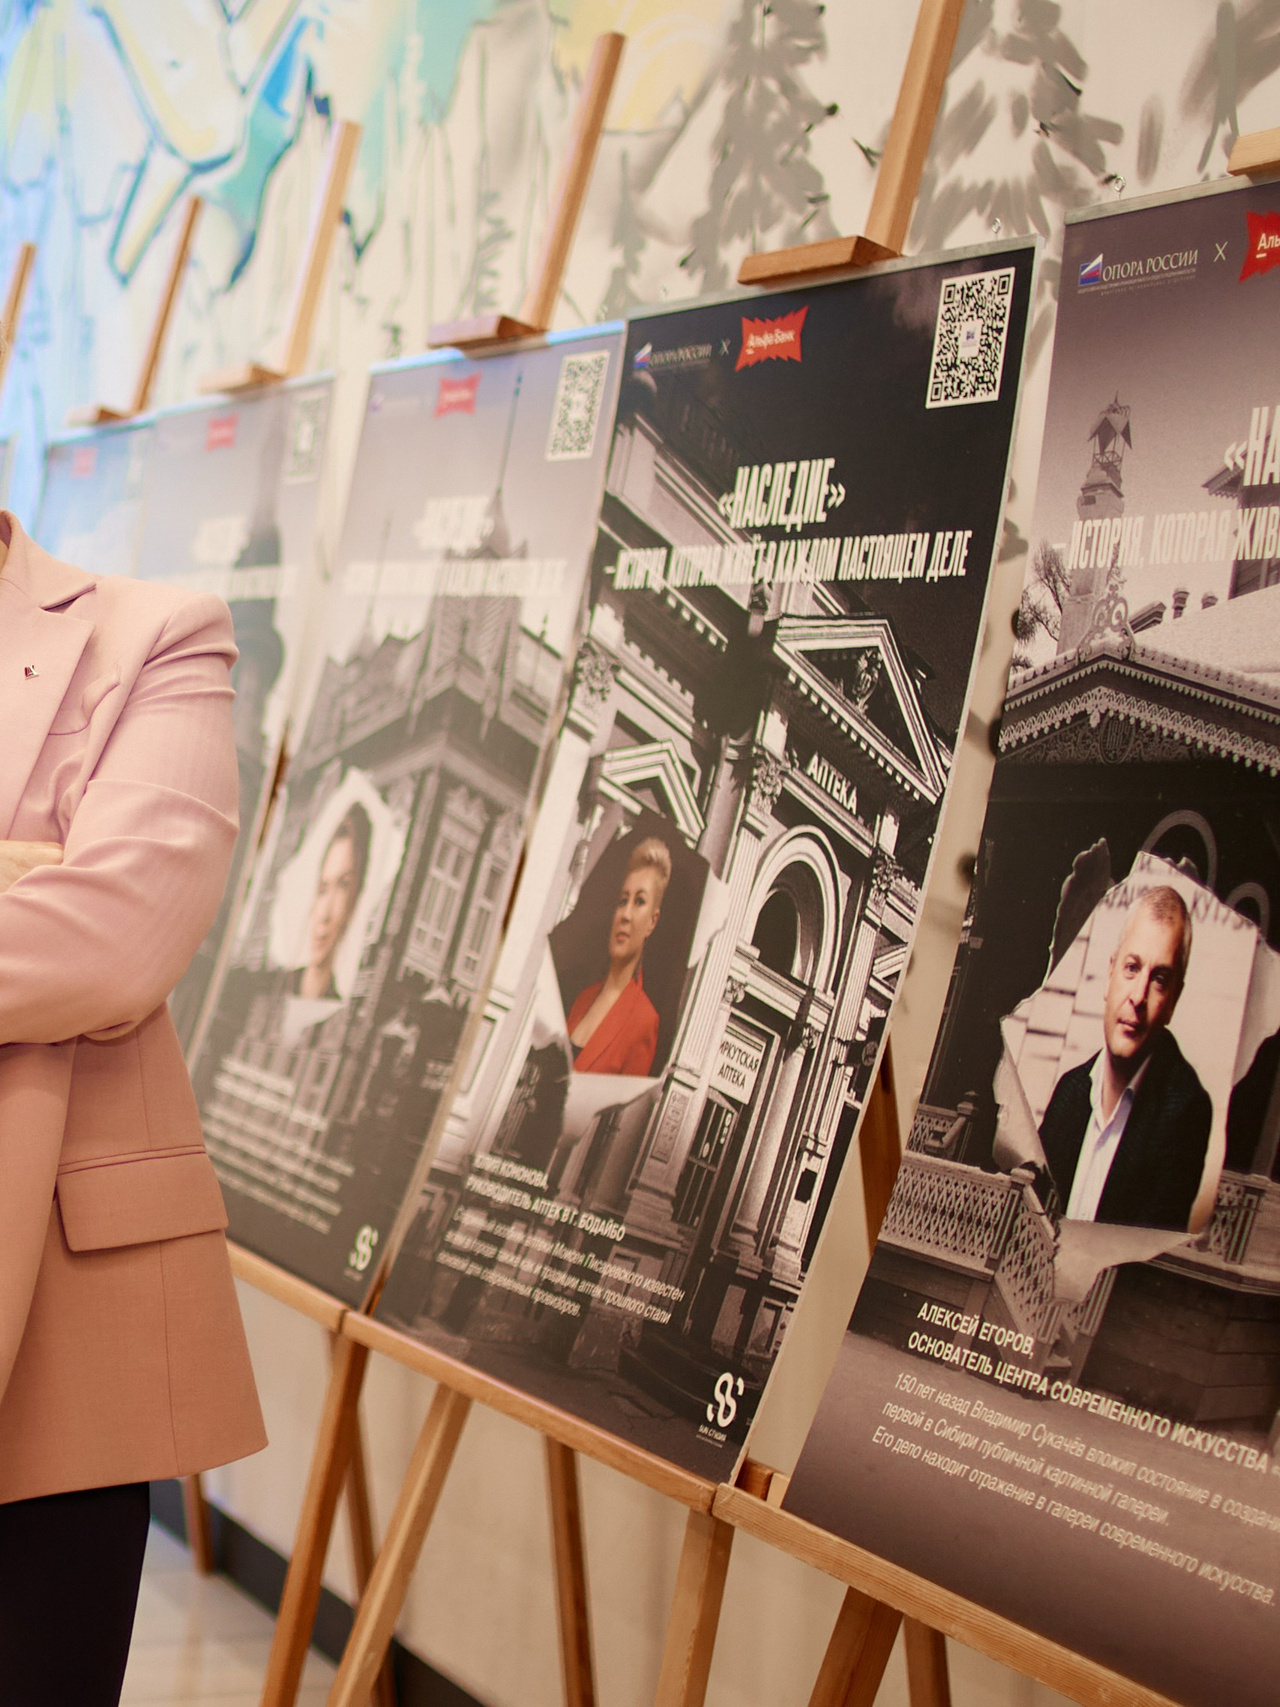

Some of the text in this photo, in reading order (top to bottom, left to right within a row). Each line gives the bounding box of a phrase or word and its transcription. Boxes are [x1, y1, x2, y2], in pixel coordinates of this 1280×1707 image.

[1102, 249, 1199, 282] ОПОРА РОССИИ
[719, 457, 846, 533] «НАСЛЕДИЕ»
[774, 537, 841, 587] КАЖДОМ
[838, 532, 930, 585] НАСТОЯЩЕМ
[926, 529, 973, 584] ДЕЛЕ
[1069, 514, 1145, 570] ИСТОРИЯ,
[1149, 509, 1233, 566] КОТОРАЯ
[805, 751, 858, 816] АПТЕКА
[718, 1062, 747, 1090] АПТЕКА
[466, 1174, 533, 1211] РУКОВОДИТЕЛЬ
[530, 1197, 564, 1221] АПТЕК
[578, 1212, 627, 1242] БОДАЙБО
[577, 1280, 603, 1299] аптек
[601, 1289, 646, 1316] прошлого
[642, 1303, 673, 1325] стали
[583, 1252, 645, 1288] Писаревского
[642, 1275, 686, 1303] известен
[916, 1301, 1036, 1361] АЛЕКСЕЙ ЕГОРОВ,
[907, 1331, 1271, 1475] ОСНОВАТЕЛЬ ЦЕНТРА СОВРЕМЕННОГО ИСКУССТВА
[881, 1402, 1170, 1528] первой в Сибири публичной картинной галереи.
[894, 1371, 918, 1394] 150
[914, 1380, 937, 1402] лет
[935, 1389, 971, 1418] назад
[969, 1399, 1033, 1441] Владимир
[1030, 1422, 1087, 1459] Сукачёв
[1083, 1446, 1139, 1478] вложил
[1134, 1465, 1211, 1505] состояние
[1208, 1493, 1224, 1510] в
[871, 1425, 1277, 1608] Его дело находит отражение в галереи современного искусства.
